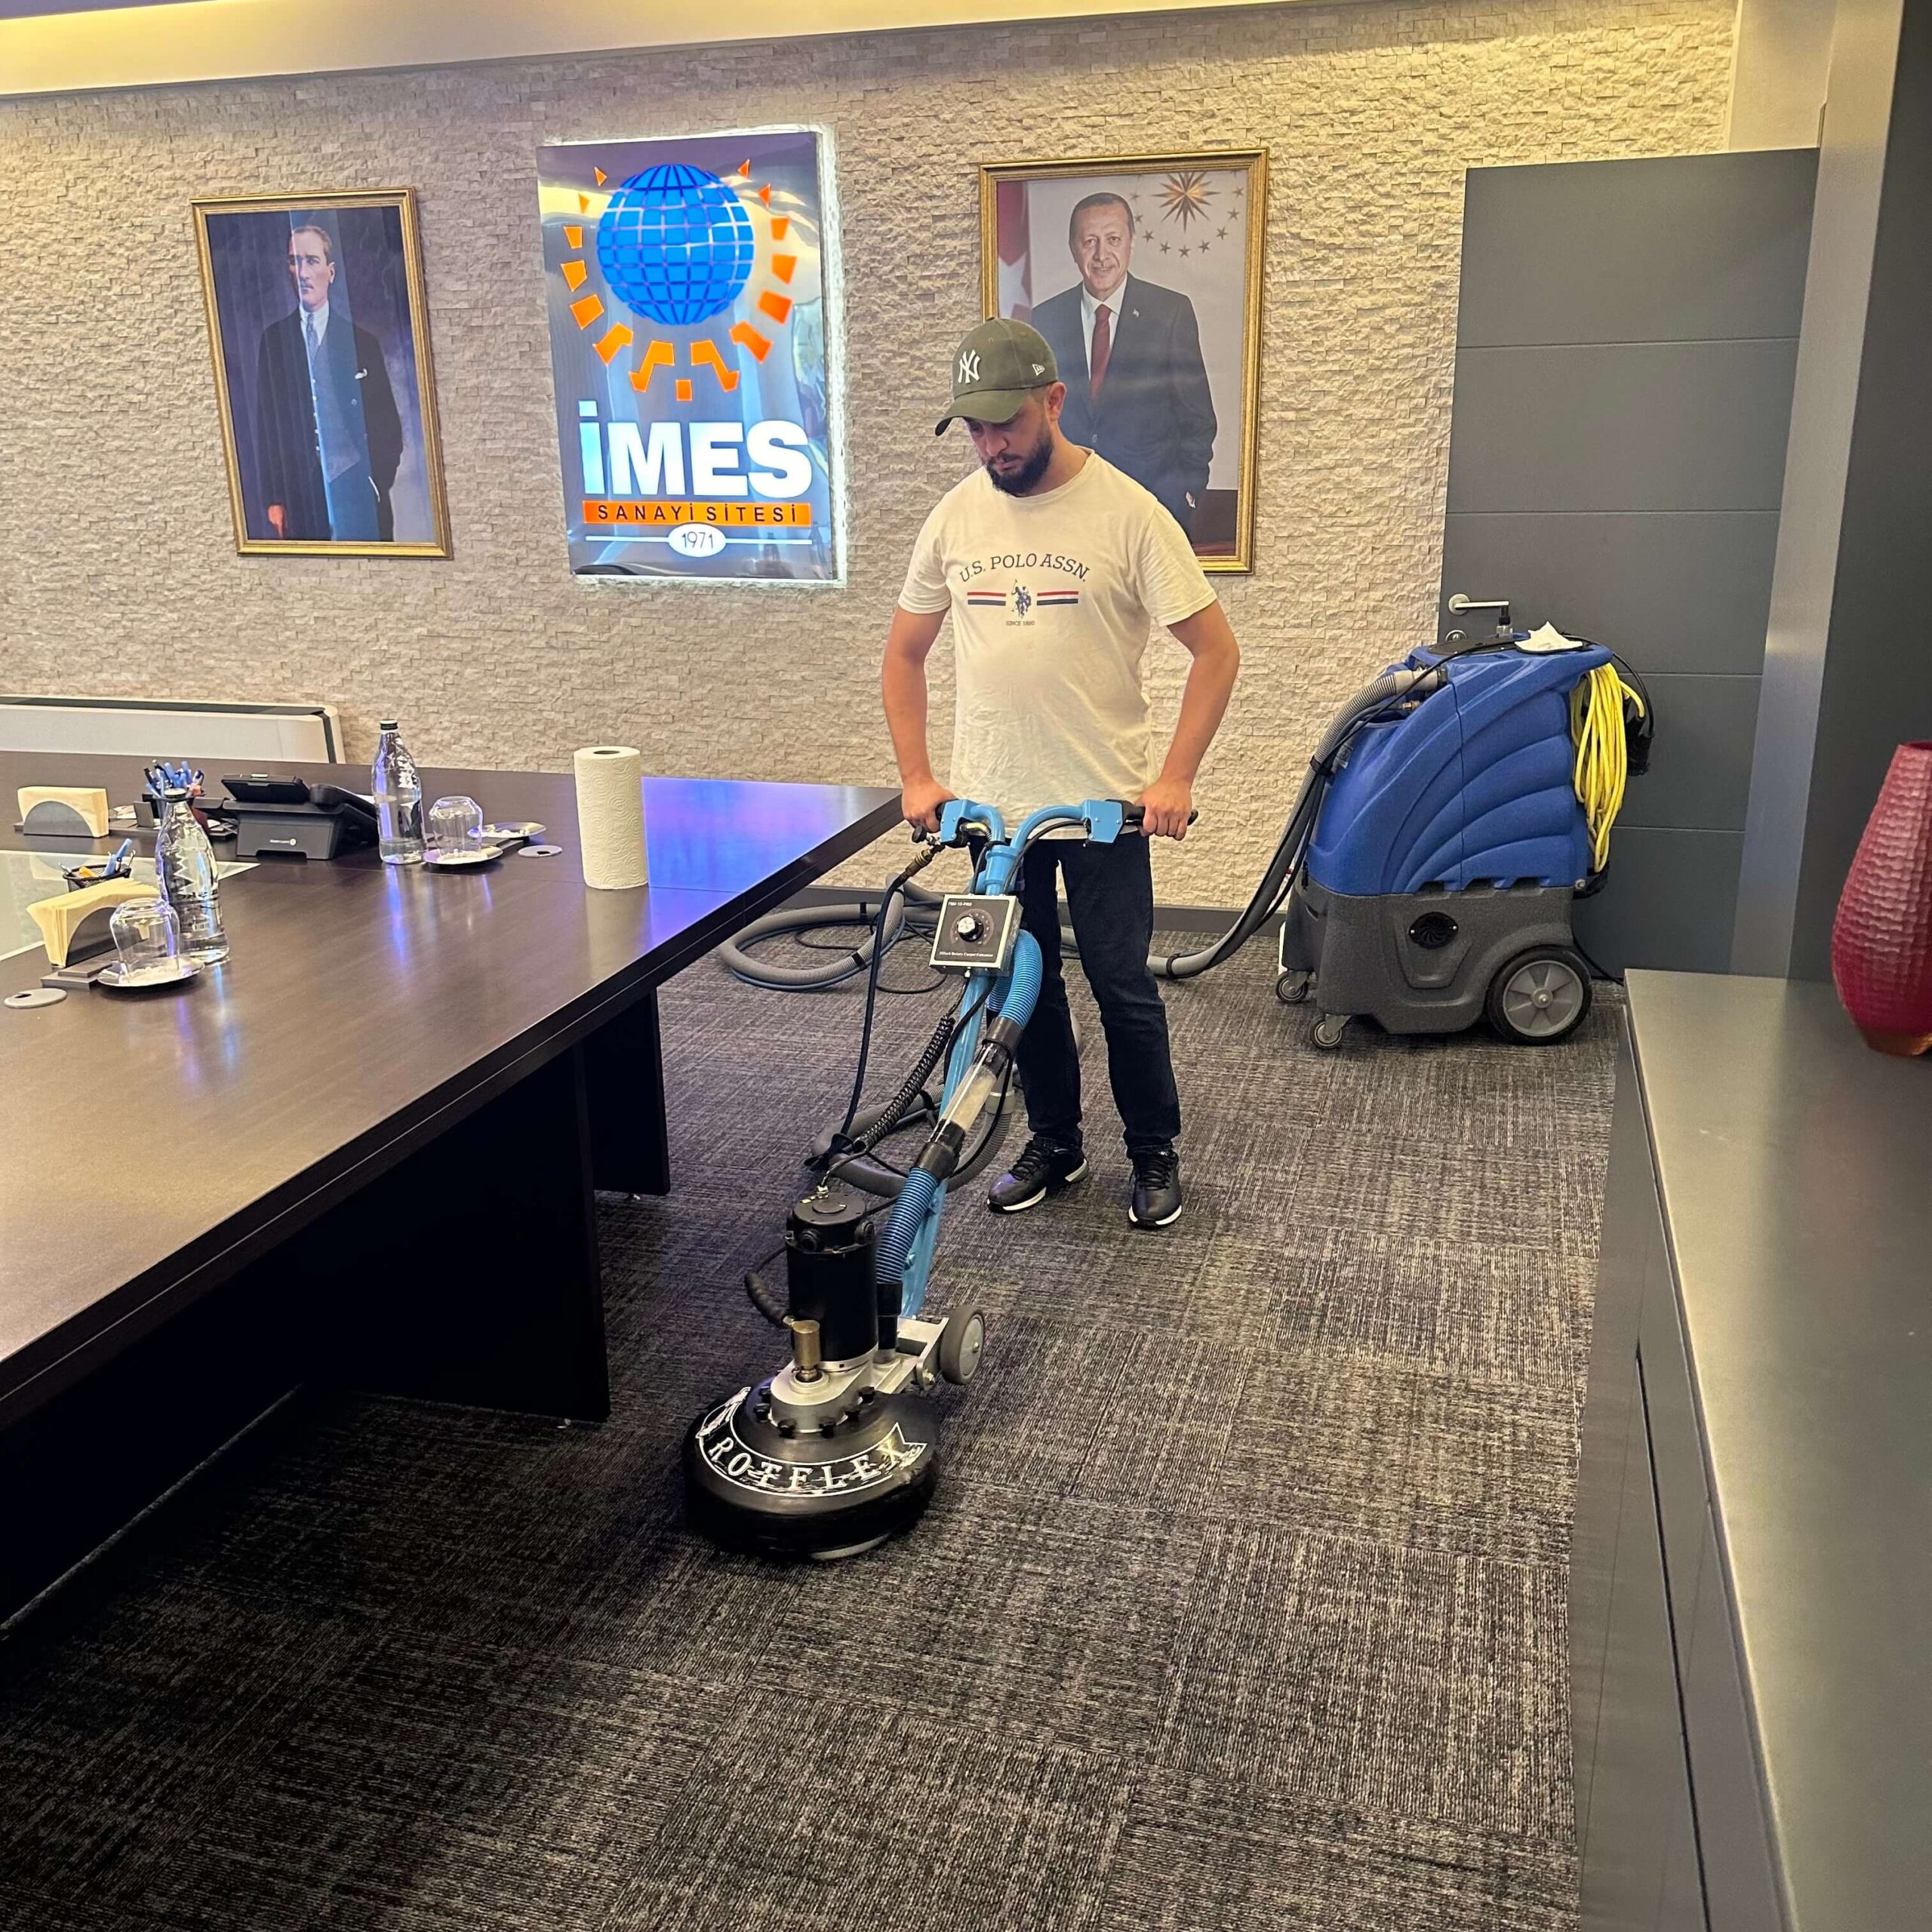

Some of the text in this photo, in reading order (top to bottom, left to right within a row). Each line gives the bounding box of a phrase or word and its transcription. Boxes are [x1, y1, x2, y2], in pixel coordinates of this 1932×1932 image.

[958, 349, 980, 383] NY
[598, 503, 796, 523] SANAYİ SİTESİ
[681, 531, 714, 549] 1971
[959, 553, 1091, 583] U.S. POLO ASSN.
